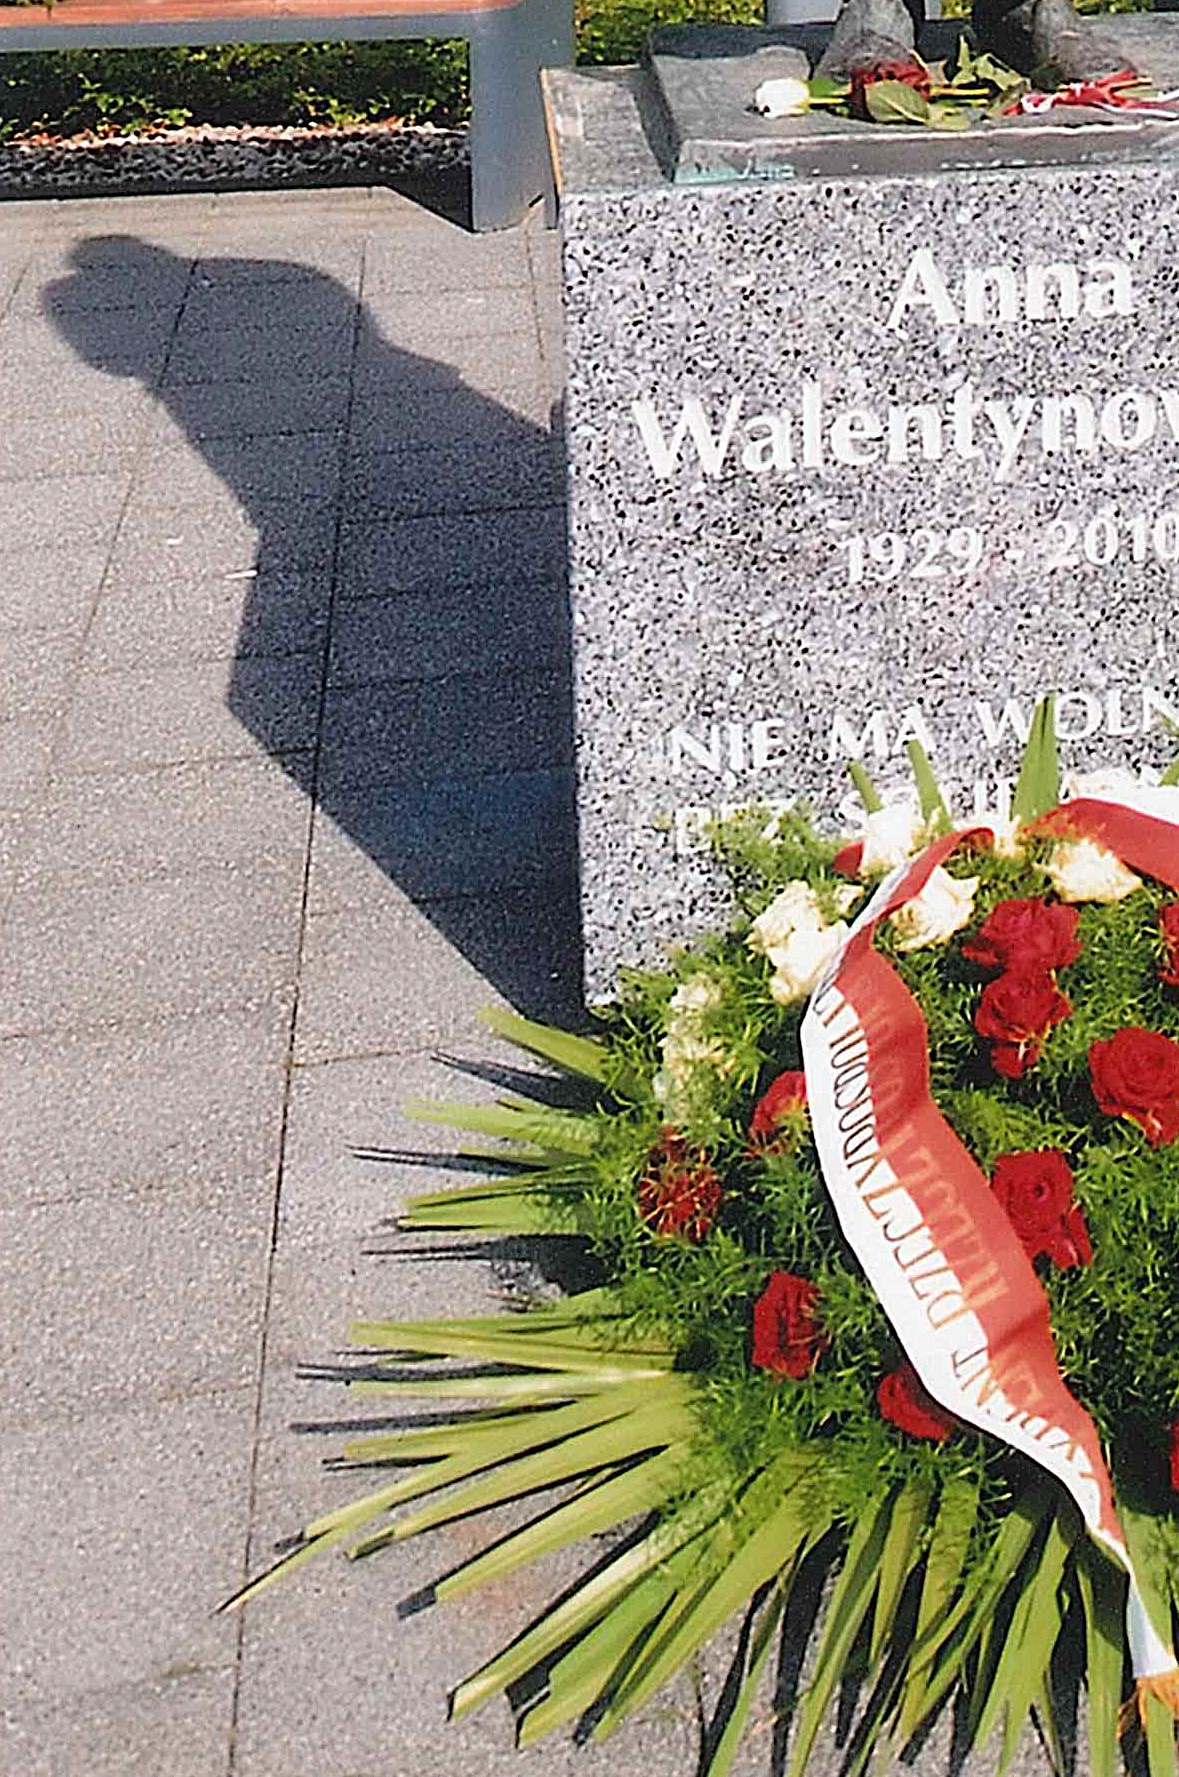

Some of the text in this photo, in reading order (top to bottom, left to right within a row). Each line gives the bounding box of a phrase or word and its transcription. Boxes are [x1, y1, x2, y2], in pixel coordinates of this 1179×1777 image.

[886, 248, 1136, 329] Anna
[838, 525, 984, 581] 1929
[669, 718, 787, 772] NIE
[829, 707, 937, 764] MA
